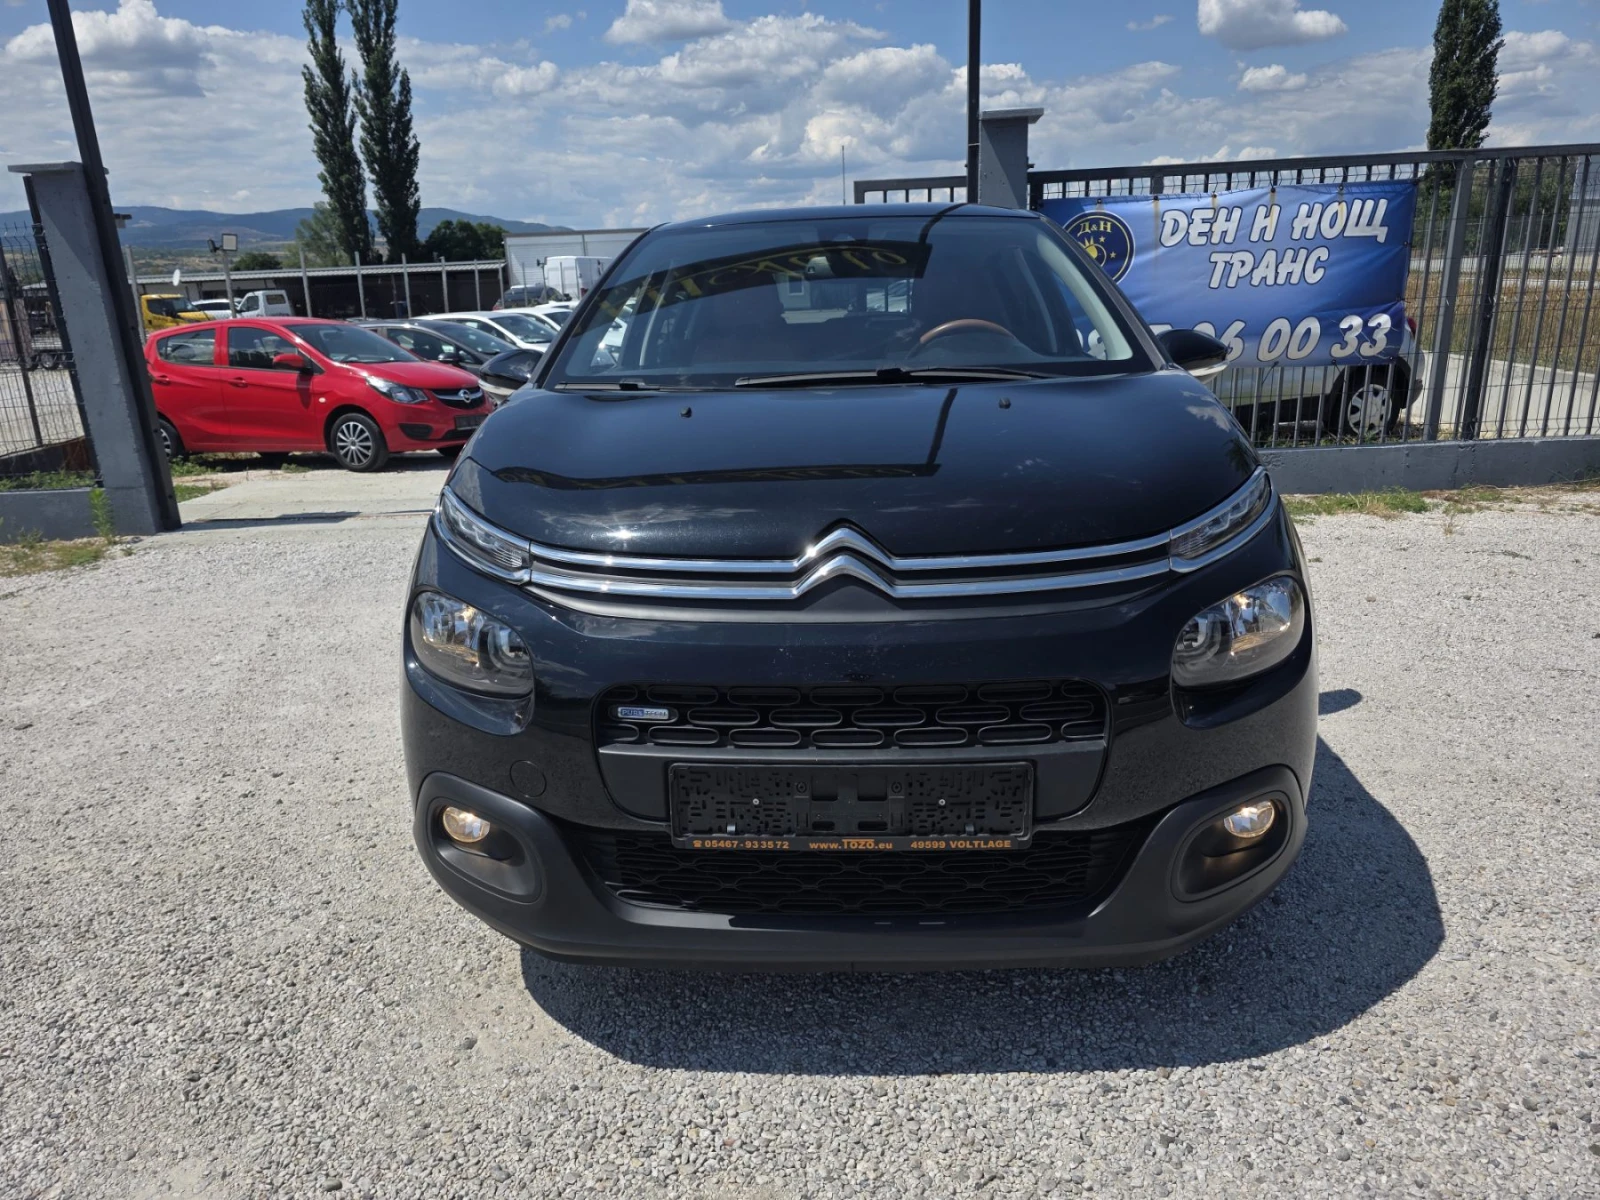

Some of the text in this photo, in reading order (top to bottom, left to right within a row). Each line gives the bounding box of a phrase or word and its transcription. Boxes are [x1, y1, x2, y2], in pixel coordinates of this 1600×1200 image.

[1160, 206, 1242, 247] ДЕН
[1291, 198, 1389, 243] НОЩ
[1209, 246, 1329, 288] ТРАНС
[1257, 316, 1321, 361] 00
[1330, 313, 1392, 358] 33
[911, 841, 946, 849] 49599
[949, 840, 1011, 848] VOLTLAGE
